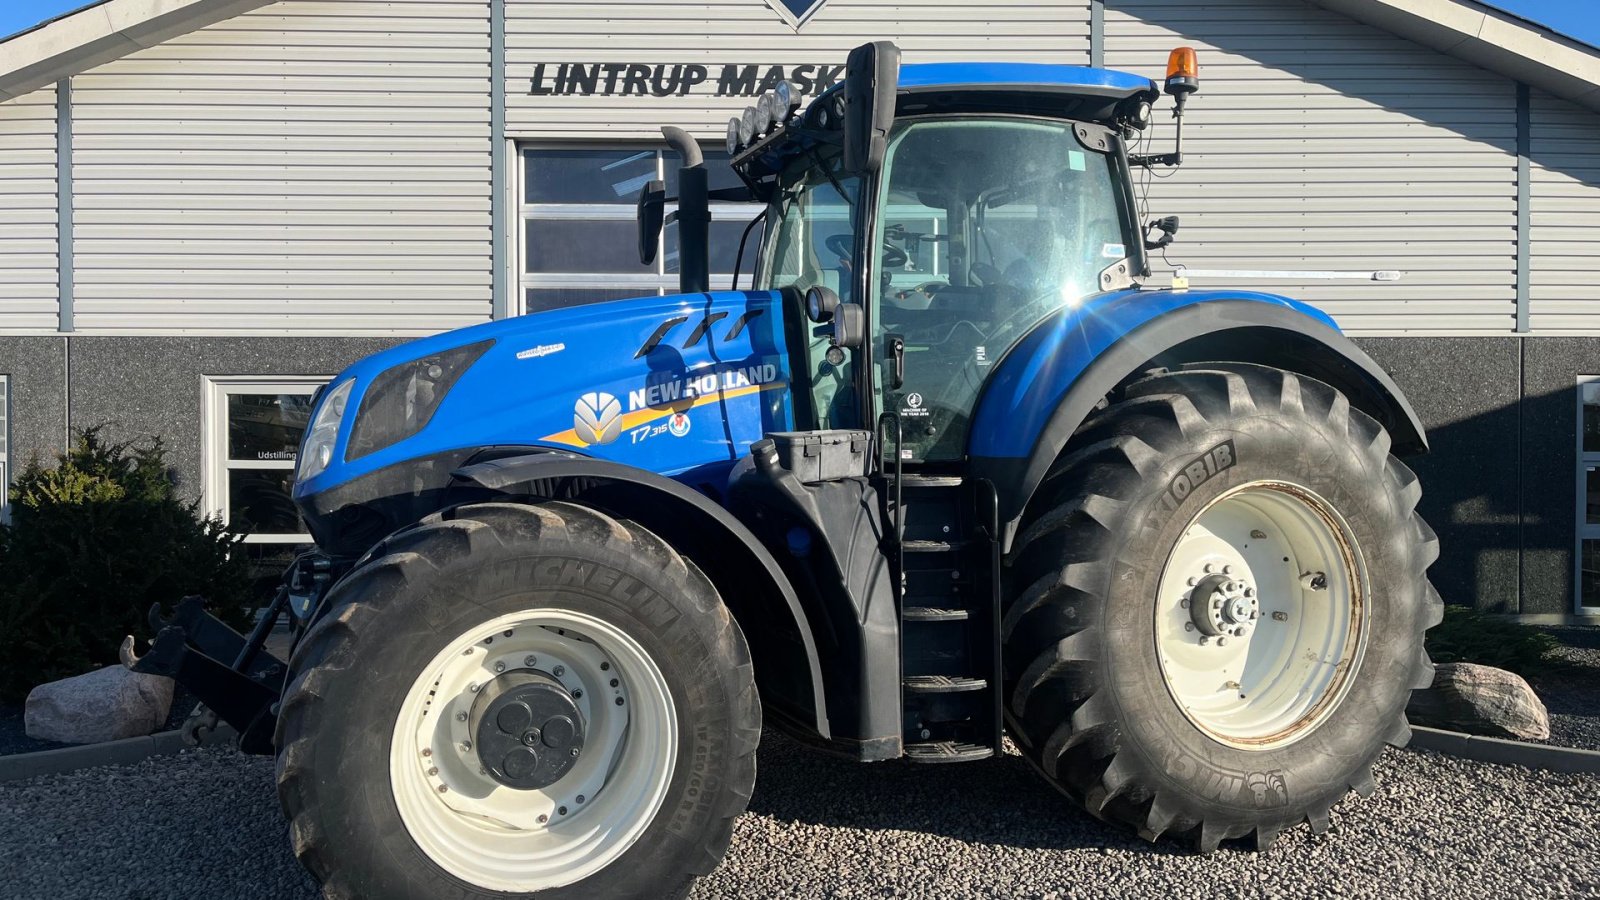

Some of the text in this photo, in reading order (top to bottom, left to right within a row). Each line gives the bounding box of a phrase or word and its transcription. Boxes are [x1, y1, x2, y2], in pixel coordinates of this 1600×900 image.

[529, 63, 846, 97] LINTRUP MASK
[629, 364, 777, 411] NEW HOLLAND
[257, 451, 297, 461] Udstilling
[476, 557, 677, 624] MICHELIN
